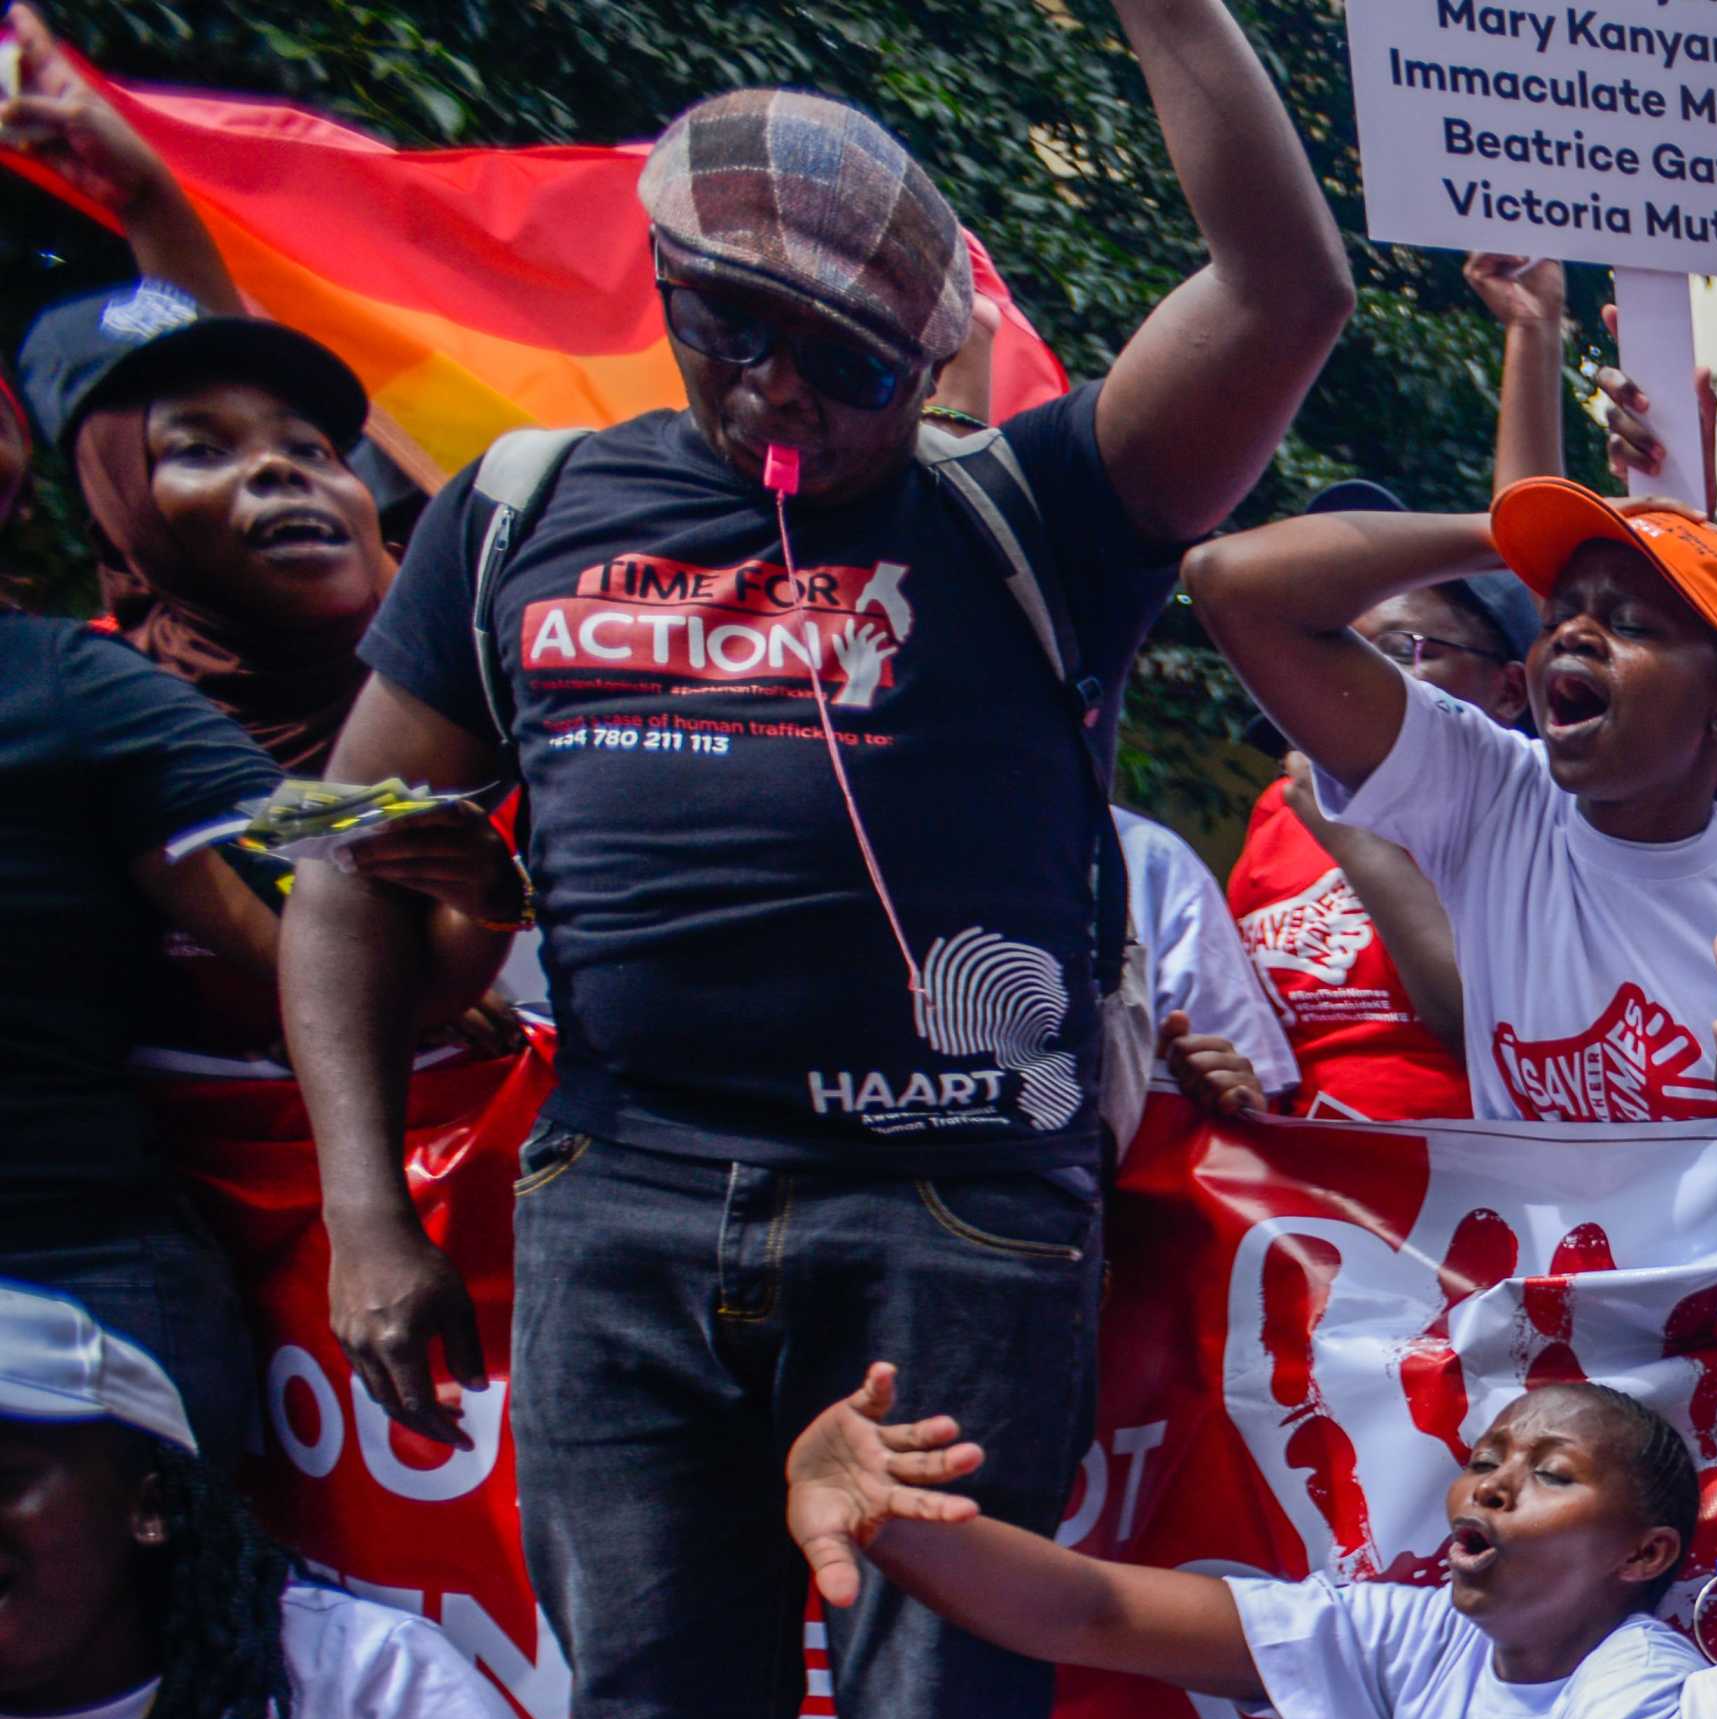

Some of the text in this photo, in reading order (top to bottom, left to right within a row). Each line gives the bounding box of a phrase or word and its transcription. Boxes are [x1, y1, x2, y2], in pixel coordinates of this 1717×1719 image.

[1438, 0, 1555, 53] Mary
[1390, 48, 1666, 118] Immaculate
[1443, 117, 1640, 175] Beatrice
[1442, 178, 1631, 236] Victoria
[600, 560, 841, 610] TIME FOR
[530, 608, 823, 673] ACTION
[593, 728, 638, 747] 780
[642, 731, 683, 750] 211
[690, 734, 730, 754] 113
[649, 712, 669, 728] of
[671, 713, 743, 734] human
[808, 1070, 1005, 1114] HAART
[1520, 1051, 1590, 1118] SAY
